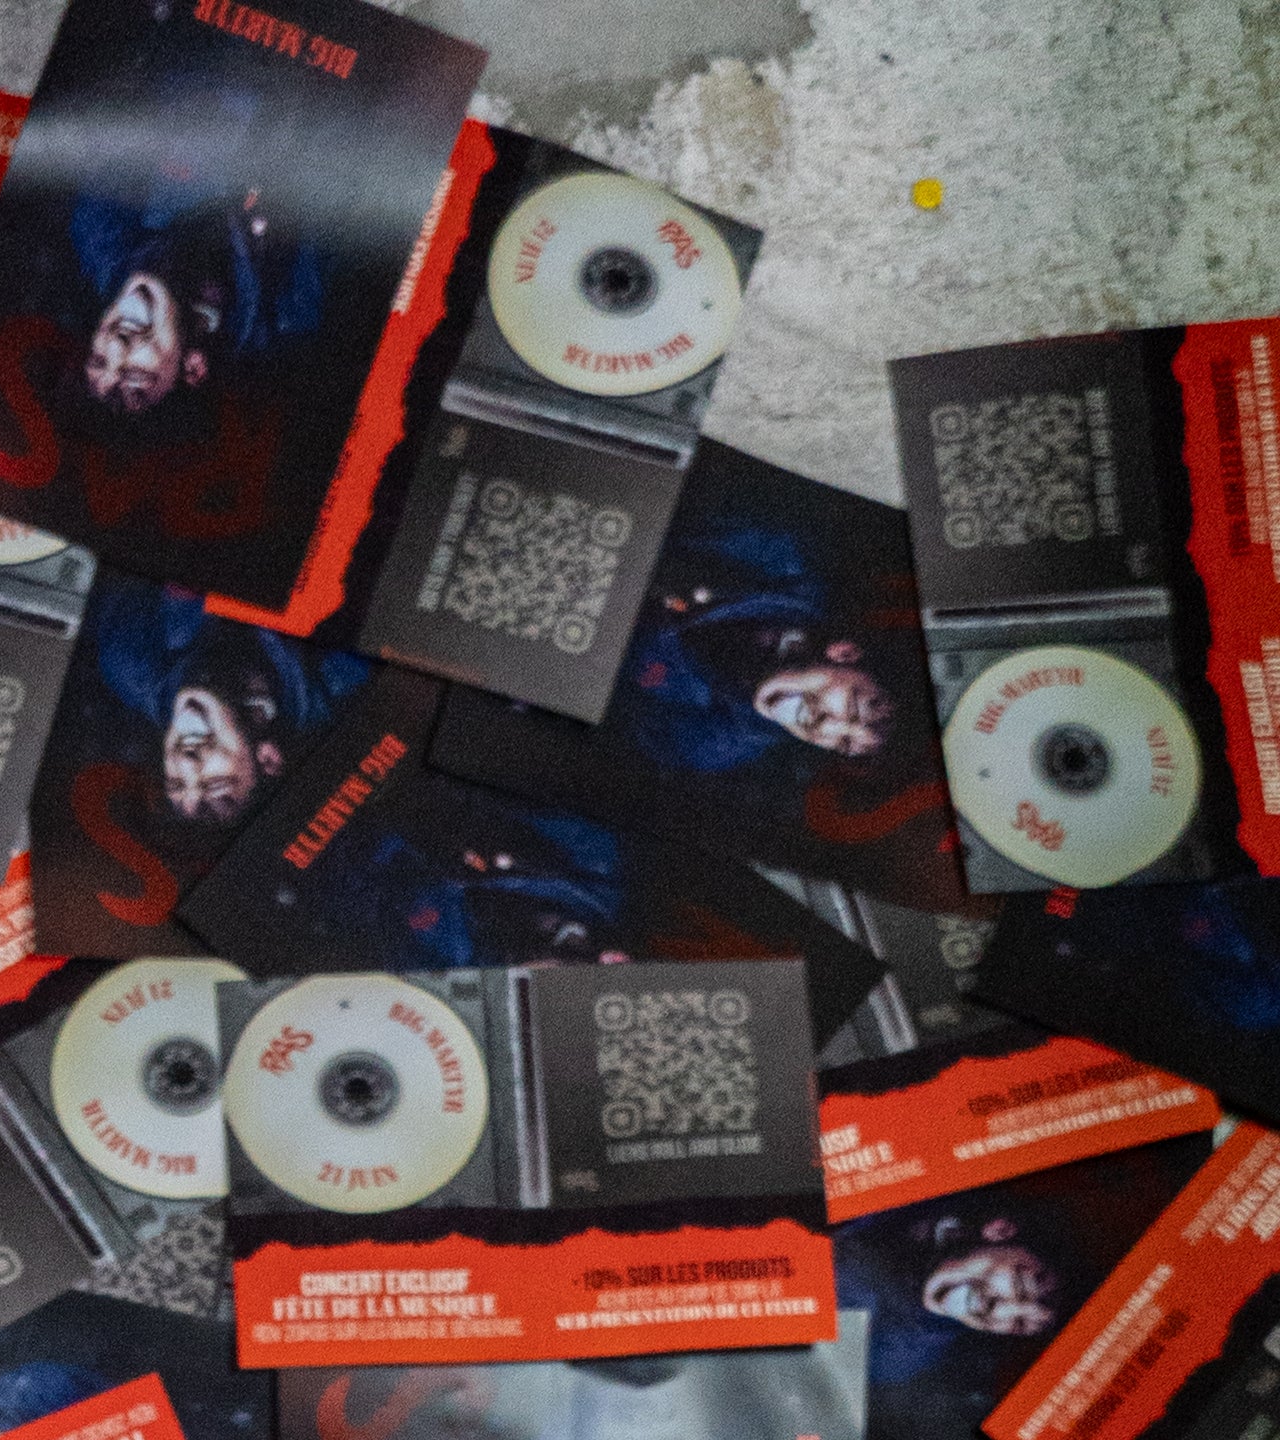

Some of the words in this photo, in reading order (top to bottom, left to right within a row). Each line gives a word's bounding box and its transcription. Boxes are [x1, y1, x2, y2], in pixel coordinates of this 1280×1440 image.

[358, 730, 409, 783] BIG
[281, 771, 374, 873] MARTYR
[258, 1024, 315, 1075] RAS
[388, 1001, 424, 1033] BIG
[425, 1028, 465, 1114] MARTYR
[317, 1161, 345, 1185] 21
[347, 1164, 399, 1190] JUIN
[298, 1270, 385, 1298] CONCERT
[384, 1267, 471, 1296] EXCLUSIF
[331, 1296, 361, 1320] DE
[365, 1295, 395, 1319] LA
[398, 1292, 498, 1321] MUSIQUE
